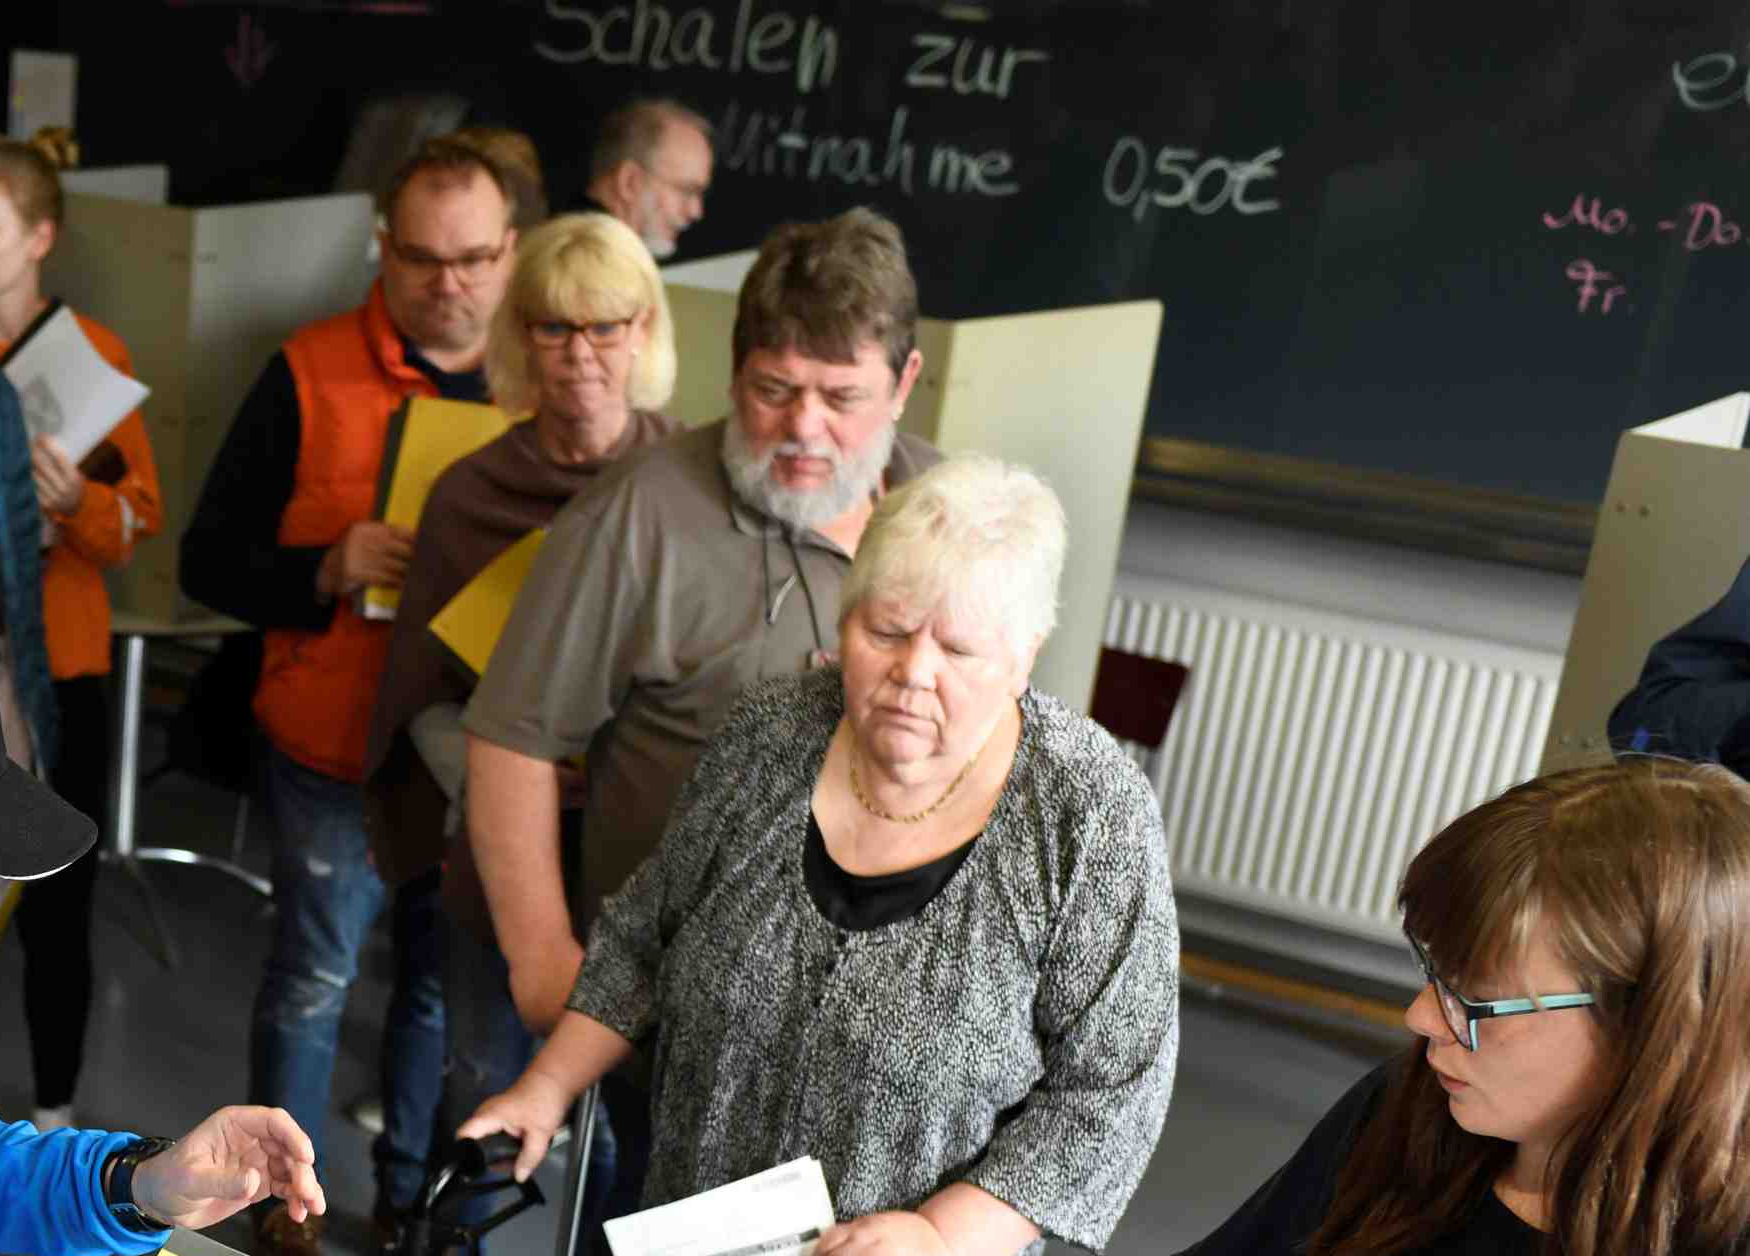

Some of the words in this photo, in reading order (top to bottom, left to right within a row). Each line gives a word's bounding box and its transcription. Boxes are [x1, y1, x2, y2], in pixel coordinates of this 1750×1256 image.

[534, 0, 840, 93] Schalen
[904, 33, 1049, 99] zur
[1672, 42, 1750, 112] e
[1102, 135, 1284, 223] 0,50€
